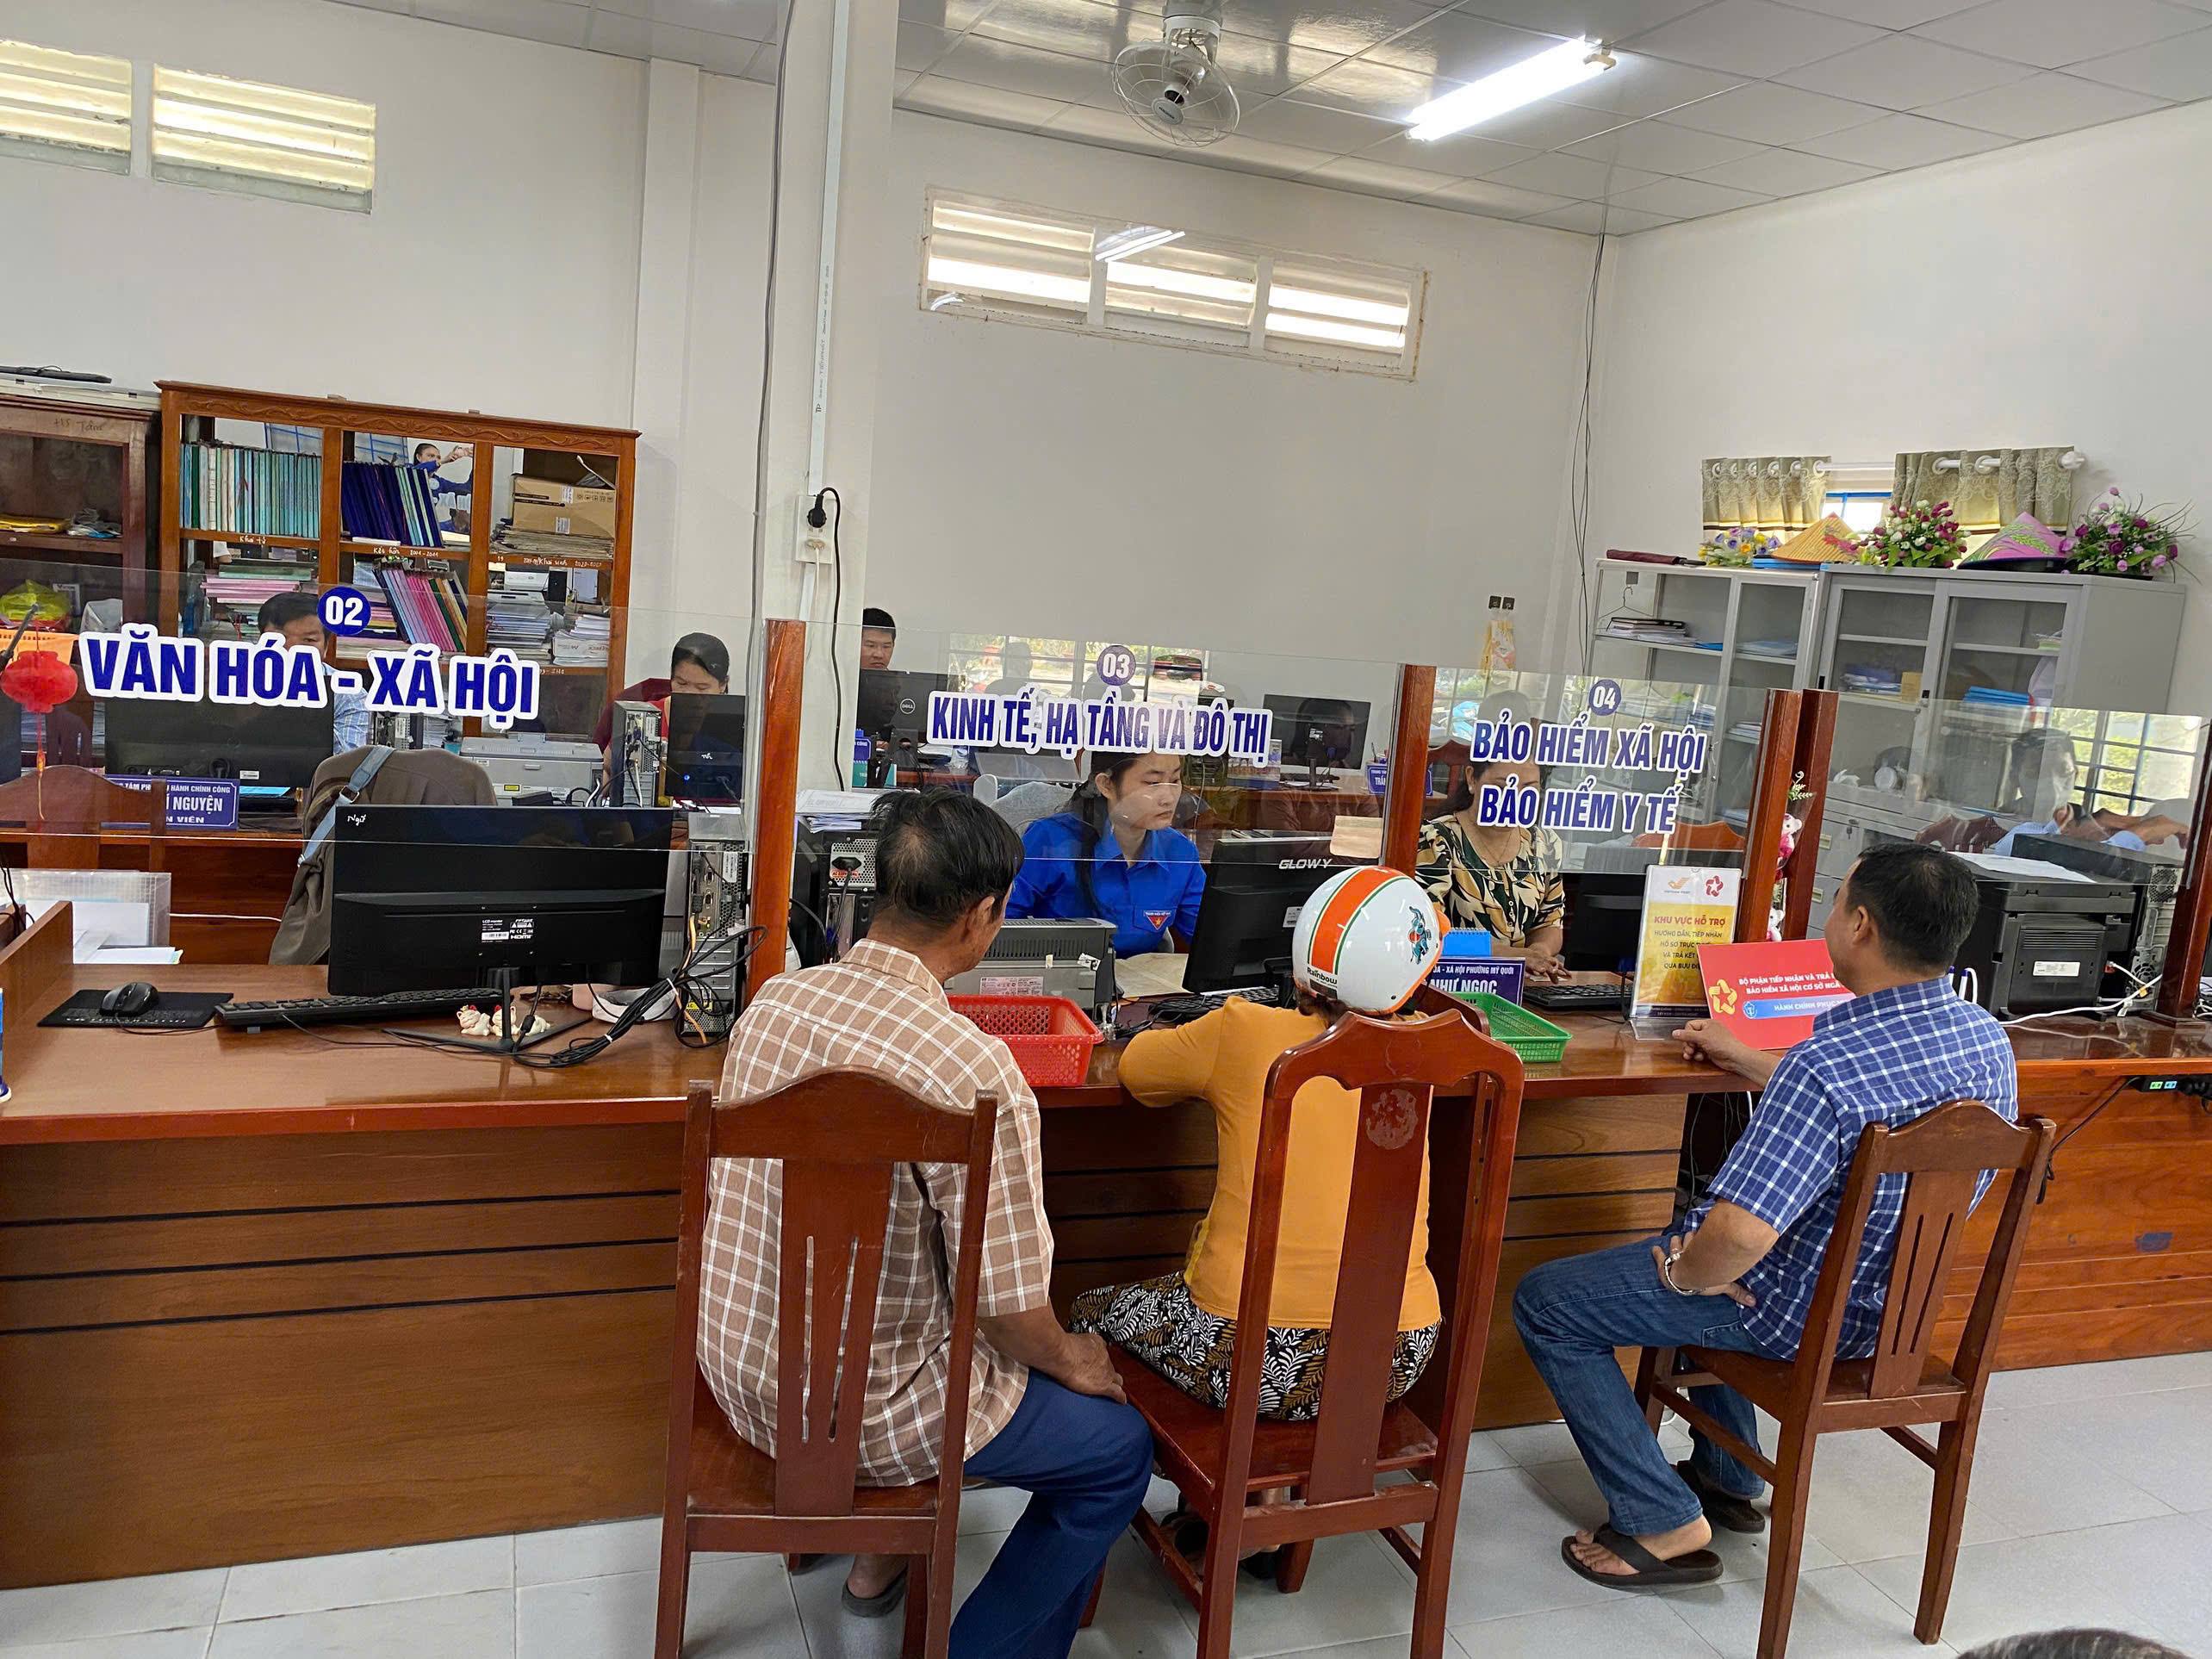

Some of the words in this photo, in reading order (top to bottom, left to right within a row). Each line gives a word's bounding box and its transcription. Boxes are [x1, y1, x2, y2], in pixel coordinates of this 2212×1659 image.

[325, 595, 363, 627] 02
[1103, 653, 1130, 679] 03
[86, 630, 196, 695] VĂN
[216, 639, 320, 701] HÓA
[371, 649, 438, 708] XÃ
[454, 654, 533, 724] HỘI
[1593, 686, 1616, 710] 04
[932, 696, 996, 742] KINH
[1003, 687, 1038, 749] TẾ,
[1045, 702, 1078, 755] HẠ
[1087, 691, 1150, 749] TẦNG
[1157, 699, 1186, 750] VÀ
[1192, 702, 1225, 752] ĐÔ
[1233, 712, 1268, 763] THỊ
[1472, 711, 1531, 761] BẢO
[1538, 713, 1610, 766] HIỂM
[1614, 724, 1653, 770] XÃ
[1658, 727, 1706, 778] HỘI
[173, 794, 223, 815] NGUYỆN
[1479, 776, 1537, 825] BẢO
[1544, 778, 1616, 830] HIỂM
[1623, 795, 1641, 830] Y
[1646, 785, 1681, 832] TẾ
[177, 815, 204, 823] VIÊN
[1278, 858, 1333, 870] GLOWY
[1675, 916, 1693, 927] VỰC
[1694, 915, 1707, 925] HỖ
[1709, 916, 1726, 928] TRỢ
[1307, 966, 1338, 985] Rainbow
[1455, 964, 1465, 975] HỘI
[1738, 977, 1749, 985] BỘ
[1749, 976, 1768, 985] PHẬN
[1768, 974, 1783, 984] TIẾP
[1784, 973, 1805, 983] NHẬN
[1816, 972, 1830, 980] TRẢ
[1746, 985, 1760, 994] BẢO
[1761, 984, 1779, 993] HIỂM
[1779, 984, 1789, 992] XÃ
[1789, 983, 1802, 992] HỘI
[1813, 981, 1824, 990] SỞ
[1824, 979, 1841, 989] NGÃ
[1794, 1001, 1816, 1010] CHÍNH
